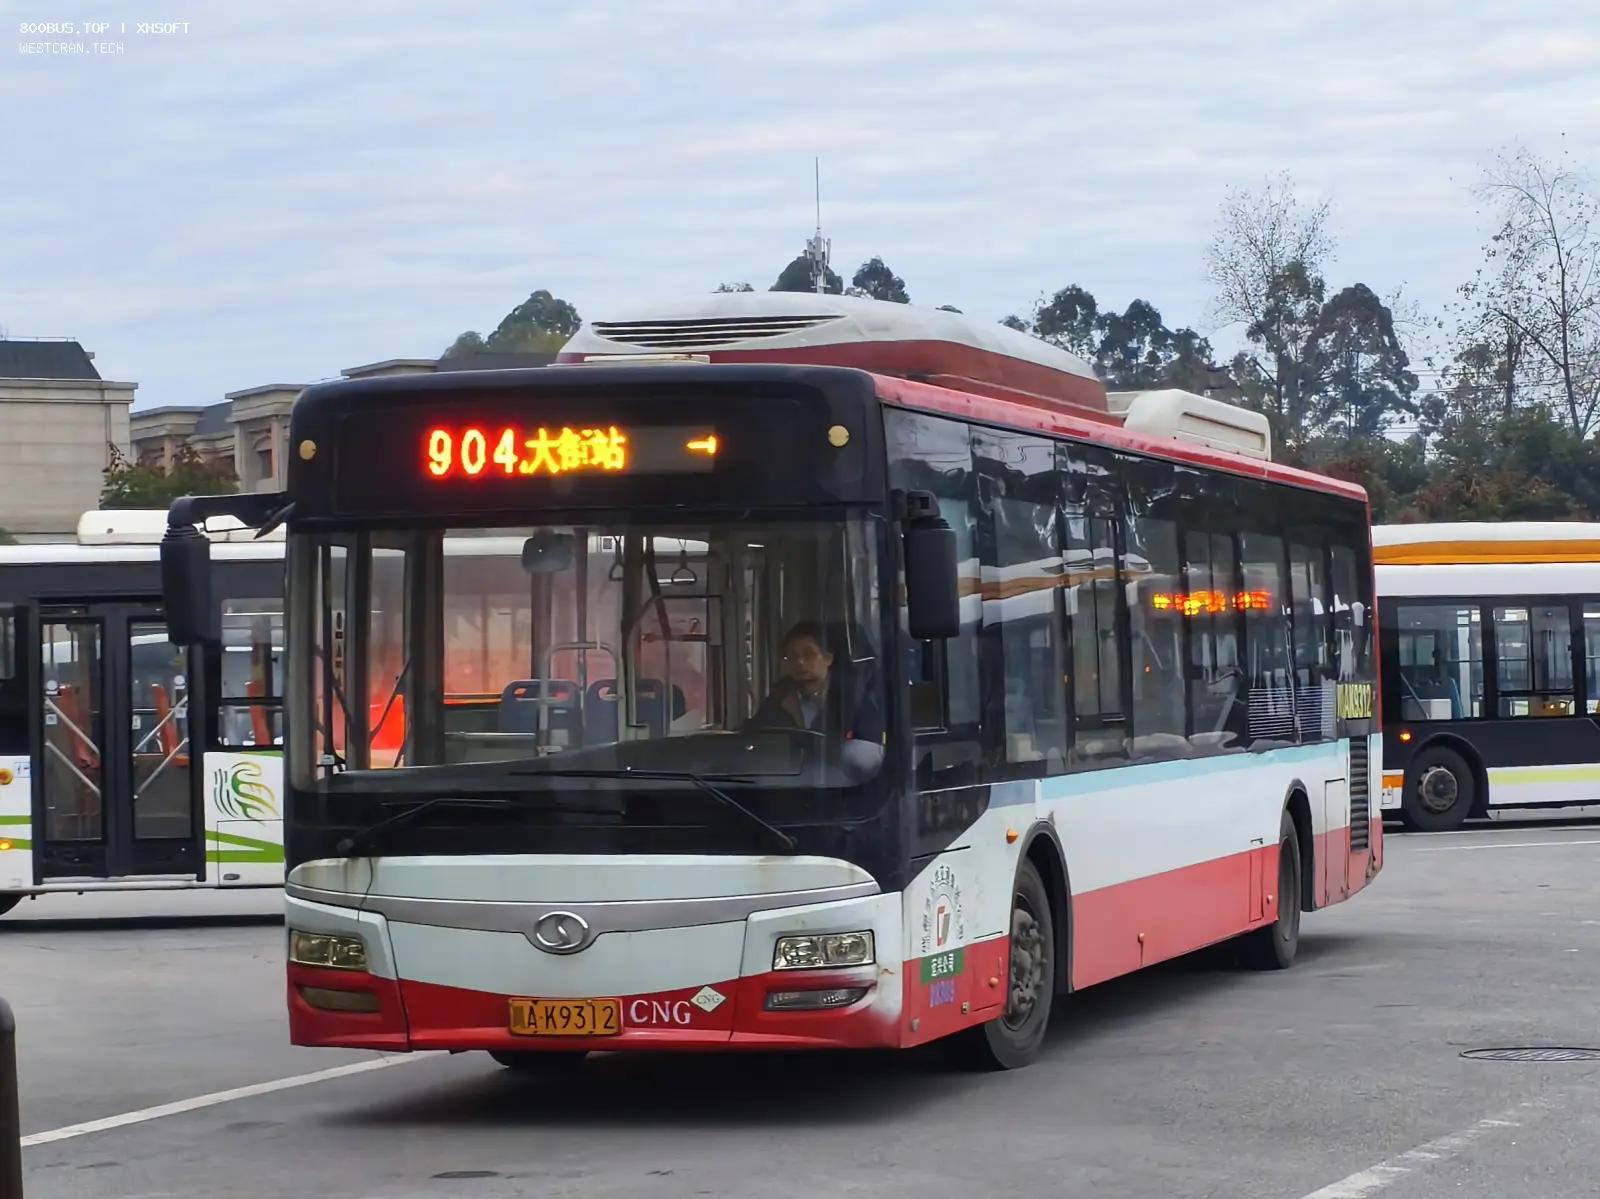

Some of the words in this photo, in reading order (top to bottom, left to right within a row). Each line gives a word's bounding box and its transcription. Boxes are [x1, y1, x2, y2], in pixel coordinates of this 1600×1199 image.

[429, 428, 518, 475] 904
[1337, 683, 1372, 719] AK9312
[630, 999, 691, 1025] CNG
[696, 992, 720, 1005] CNG
